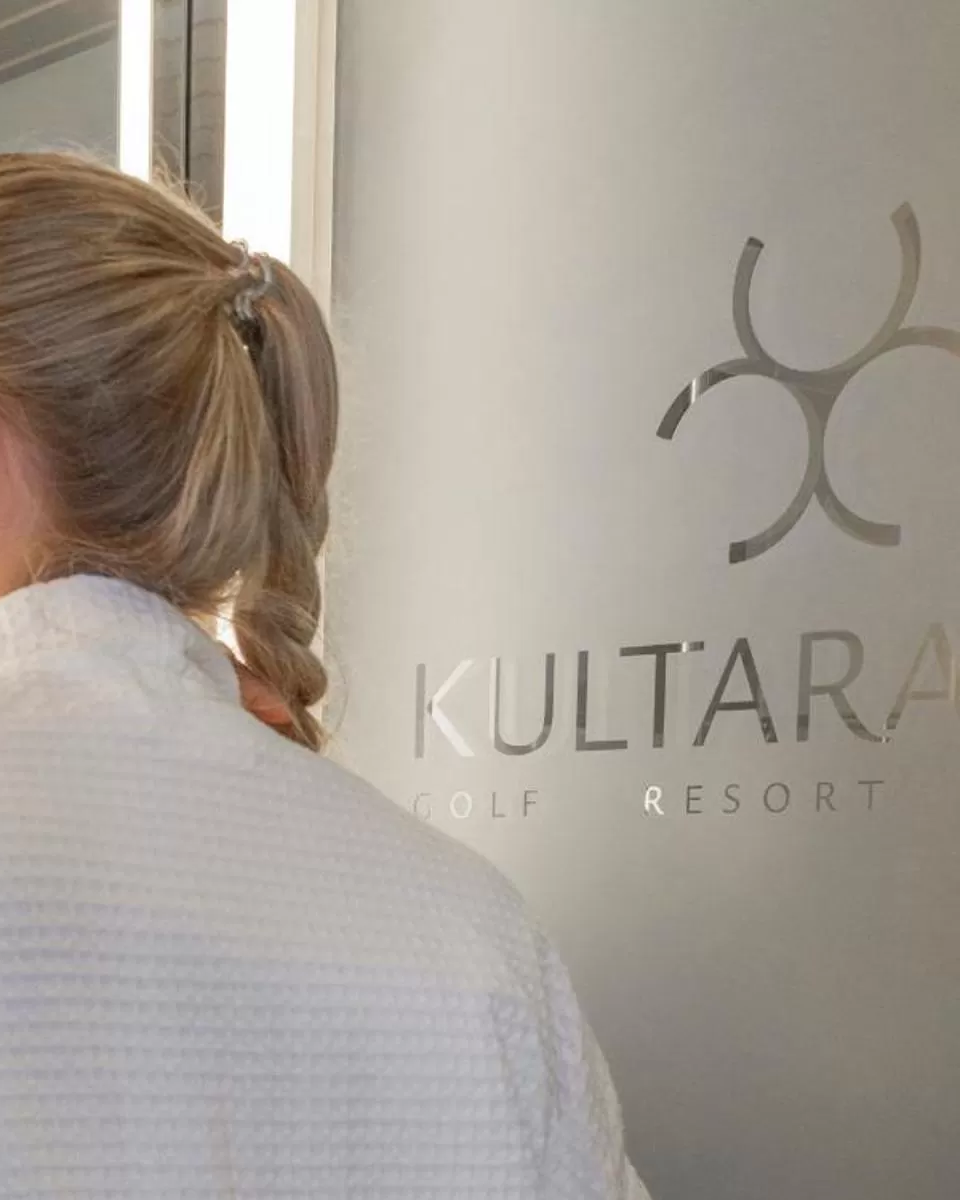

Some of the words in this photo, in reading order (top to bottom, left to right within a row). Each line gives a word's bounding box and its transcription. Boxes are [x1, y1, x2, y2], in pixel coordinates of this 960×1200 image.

[415, 622, 957, 758] KULTARA
[411, 789, 539, 821] GOLF
[644, 779, 885, 816] RESORT
